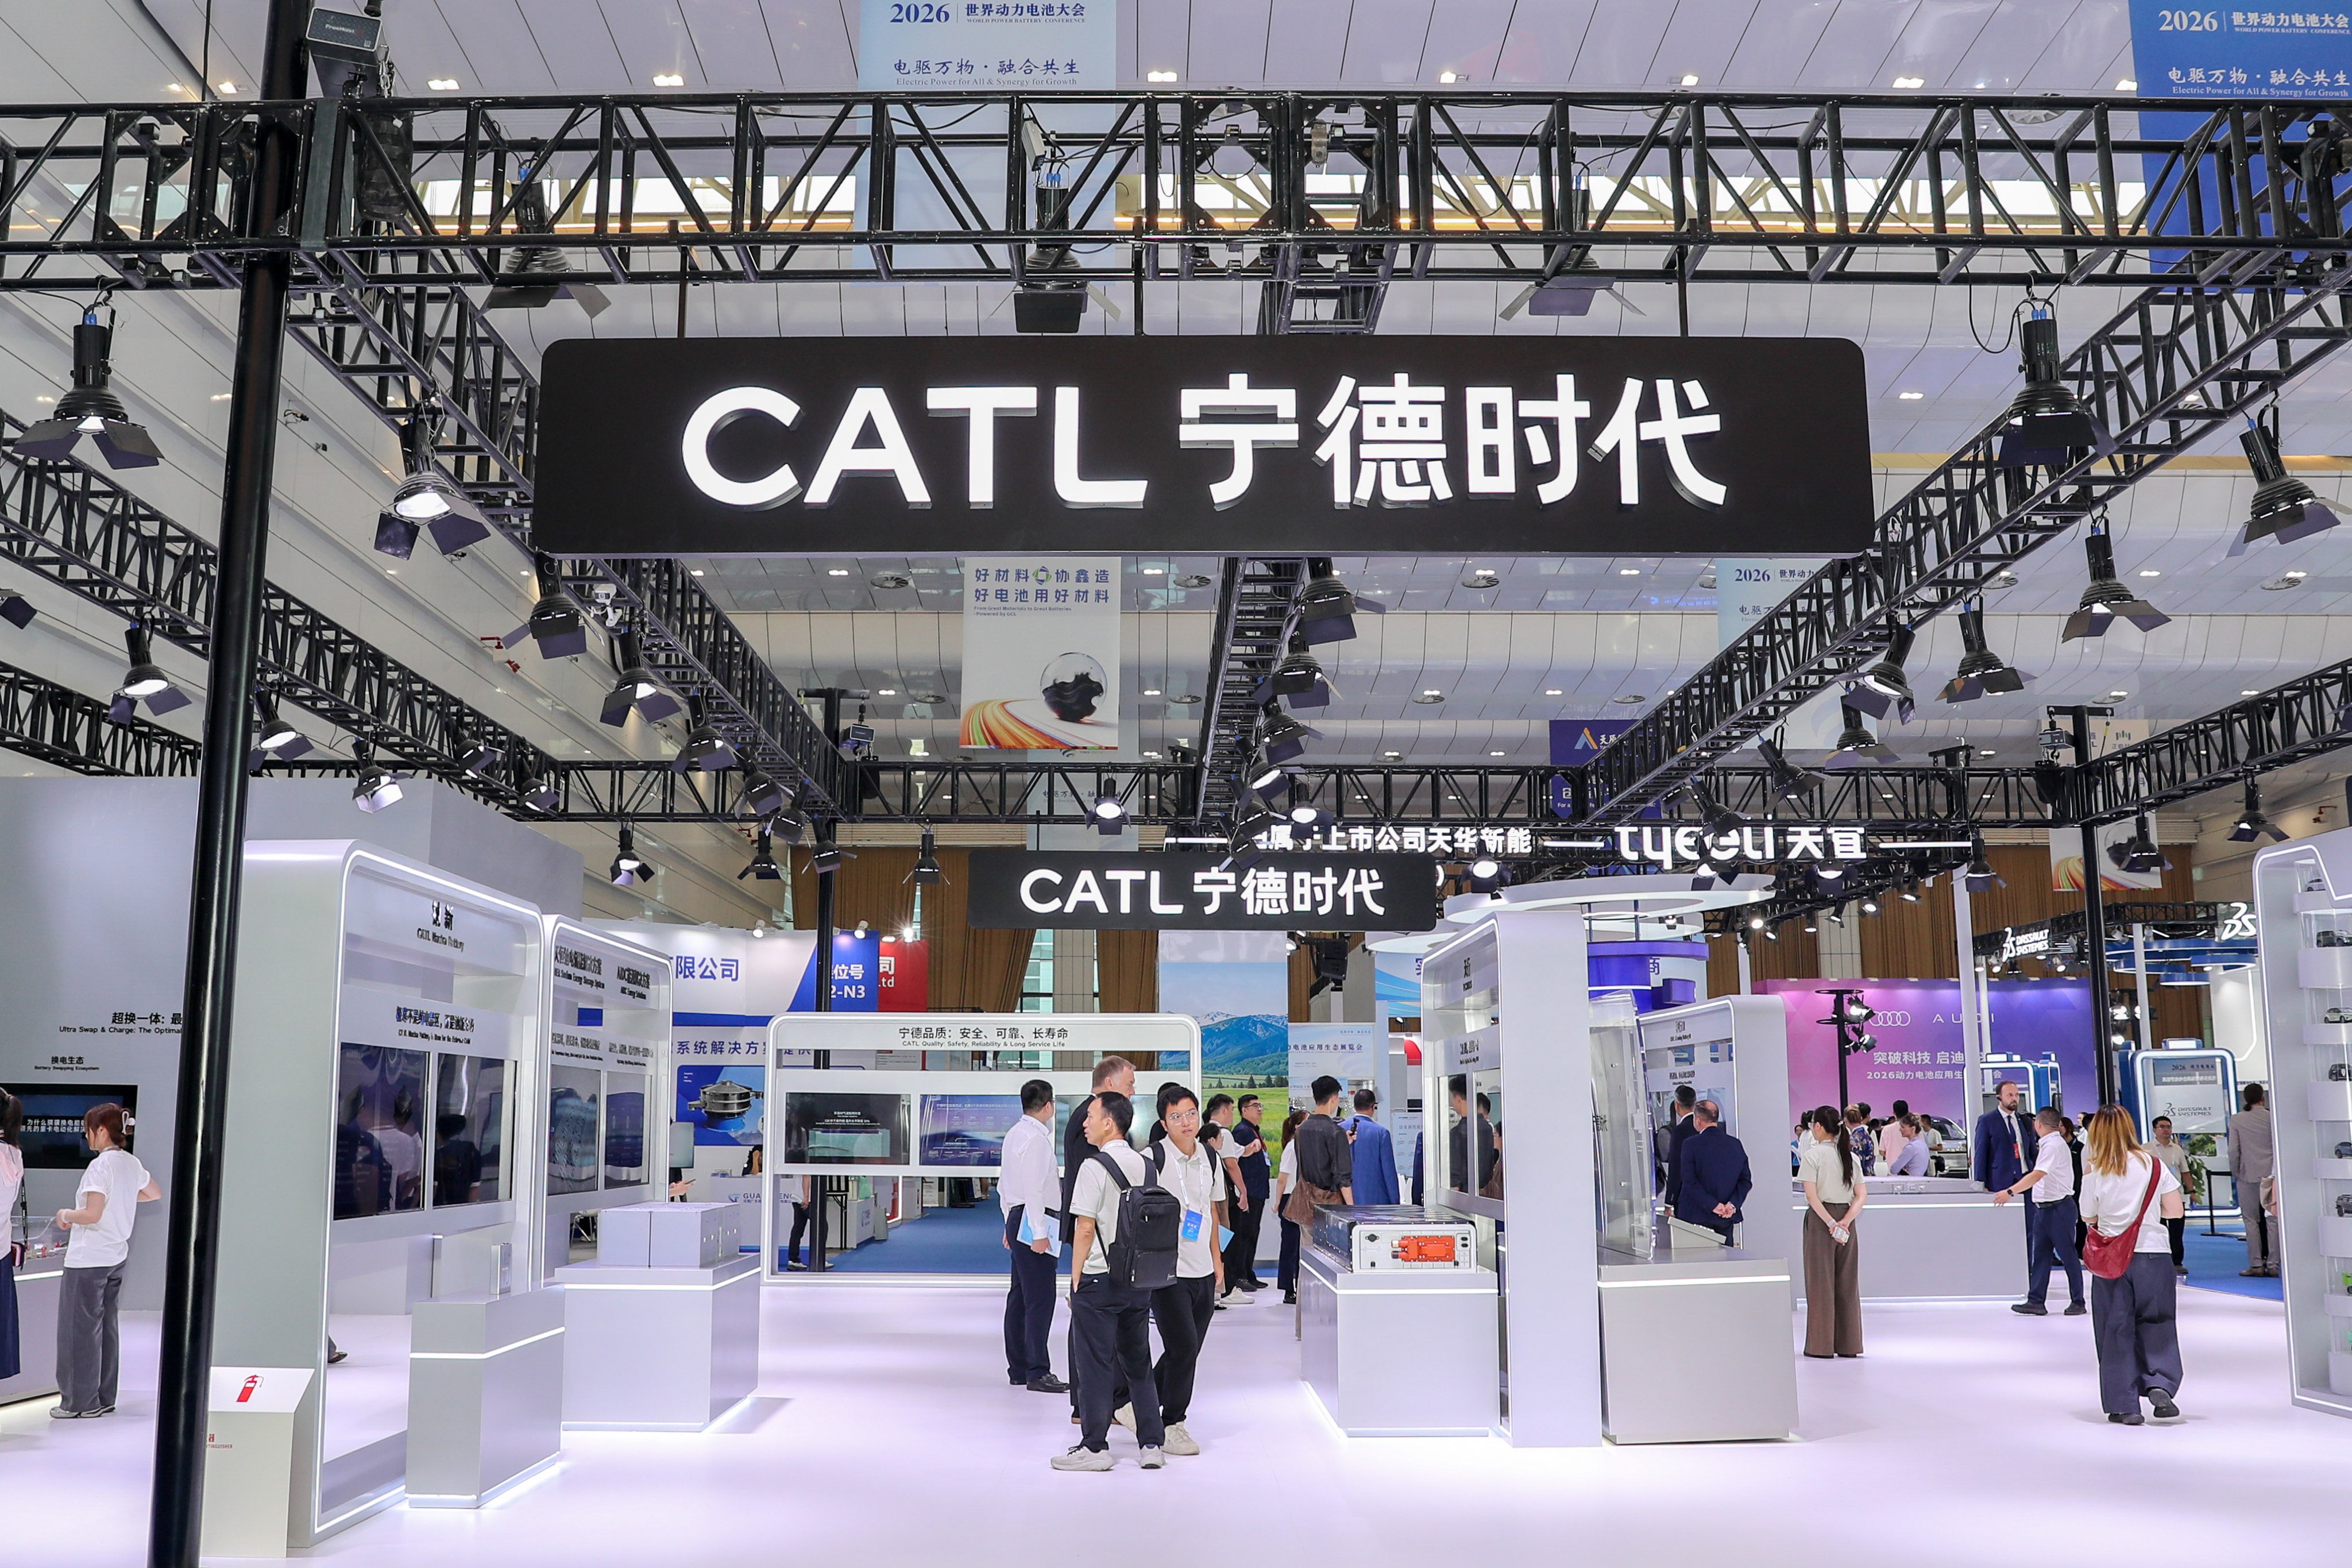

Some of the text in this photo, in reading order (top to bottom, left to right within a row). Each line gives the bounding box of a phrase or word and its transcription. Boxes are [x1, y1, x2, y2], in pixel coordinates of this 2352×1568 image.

[890, 3, 1085, 23] 2026 世界动力电池大会
[2158, 10, 2349, 32] 2026 世界动力电池大会
[997, 78, 1029, 87] Synergy
[2270, 88, 2303, 97] Synergy
[2318, 88, 2349, 97] Growth
[681, 371, 1729, 511] CATL 宁德时代
[975, 568, 1109, 584] 好材料 协鑫造
[1735, 569, 1770, 582] 2026
[975, 588, 1109, 603] 好电池用好材料
[1787, 826, 1867, 859] 天宜
[1019, 867, 1386, 916] CATL 宁德时代
[669, 955, 740, 982] 限公司
[879, 975, 894, 988] td
[899, 1027, 1069, 1040] 宁德品质：安全、可靠、长寿命
[672, 1040, 767, 1056] 系统解决方
[51, 1056, 84, 1065] 换电生态
[1874, 1051, 1931, 1065] 突破科技
